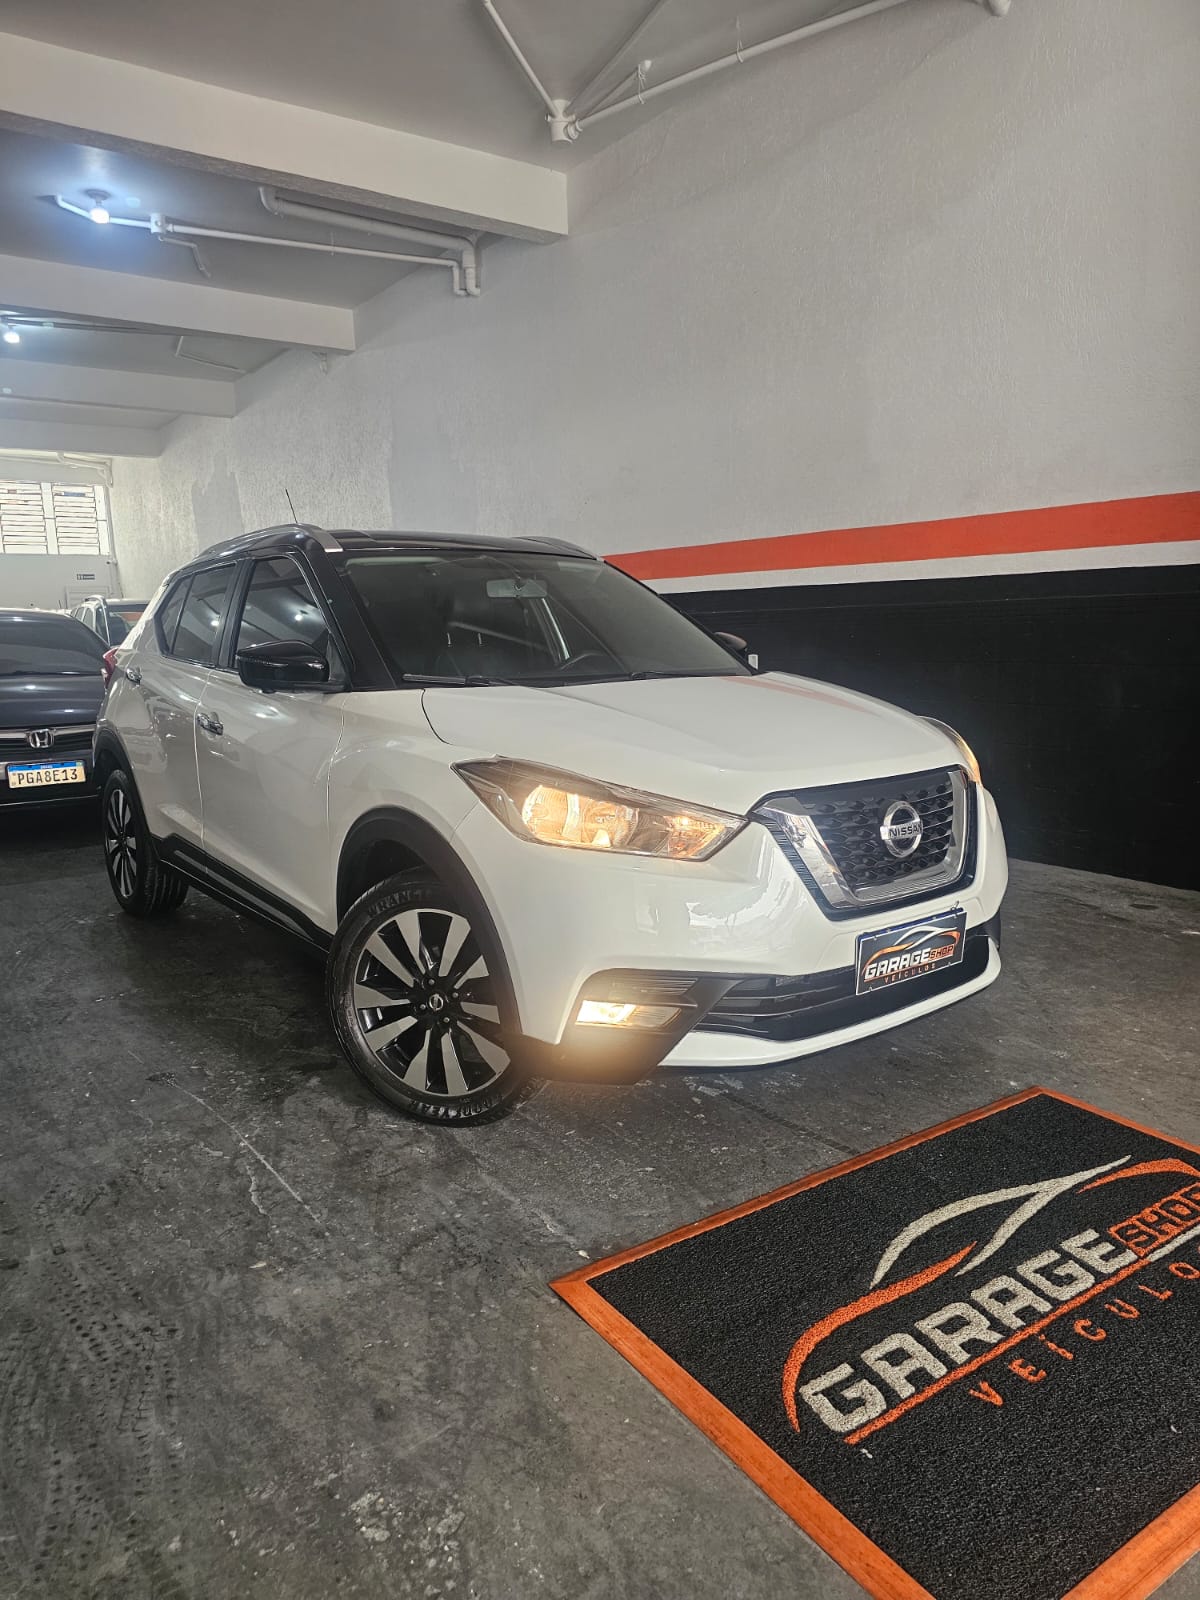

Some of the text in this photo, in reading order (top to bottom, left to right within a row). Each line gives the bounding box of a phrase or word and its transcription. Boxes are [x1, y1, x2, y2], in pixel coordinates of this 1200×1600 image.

[17, 768, 78, 785] PGA8E13
[888, 823, 922, 837] NISSAN
[864, 945, 954, 978] GARAGE SHOP
[799, 1228, 1139, 1434] GARAGE
[968, 1244, 1200, 1407] VEÍCULO
